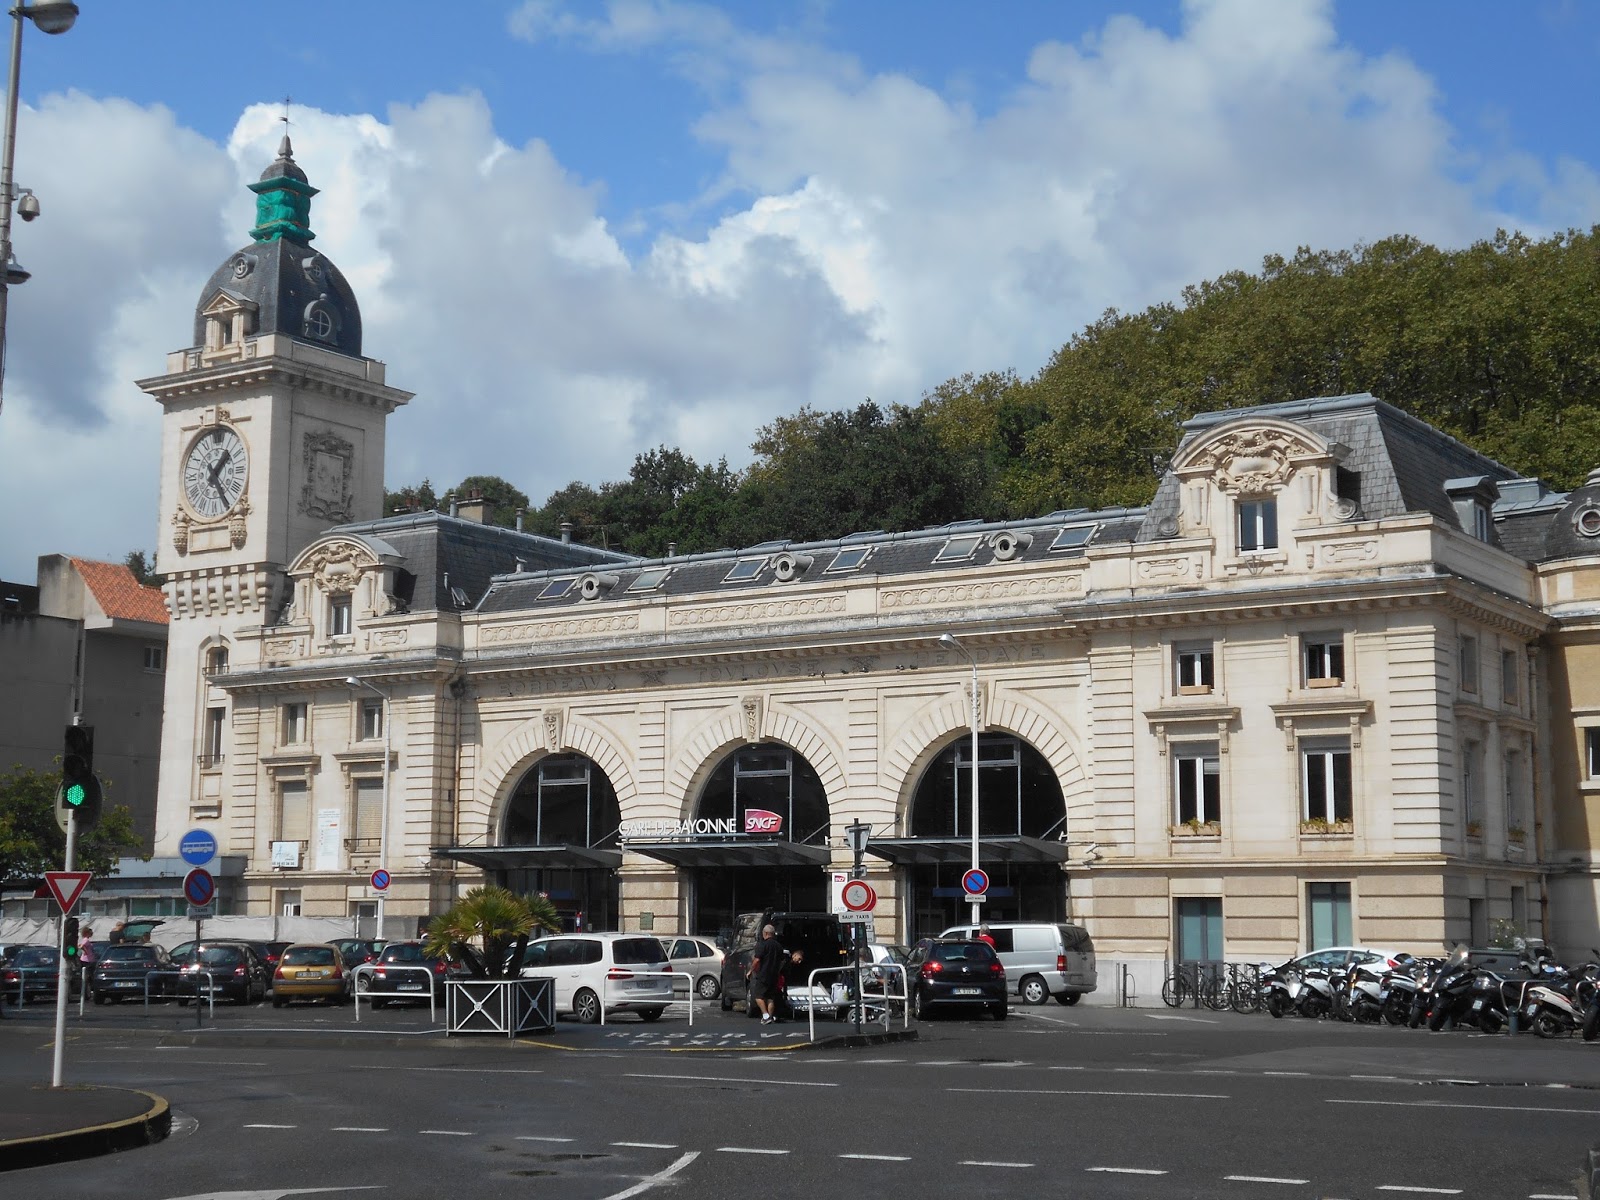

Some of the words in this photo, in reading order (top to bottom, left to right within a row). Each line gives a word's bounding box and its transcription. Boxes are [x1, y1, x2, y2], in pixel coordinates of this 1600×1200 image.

[619, 820, 652, 836] GARE
[656, 820, 670, 834] DE
[674, 818, 737, 834] BAYONNE
[746, 817, 777, 829] SNCF
